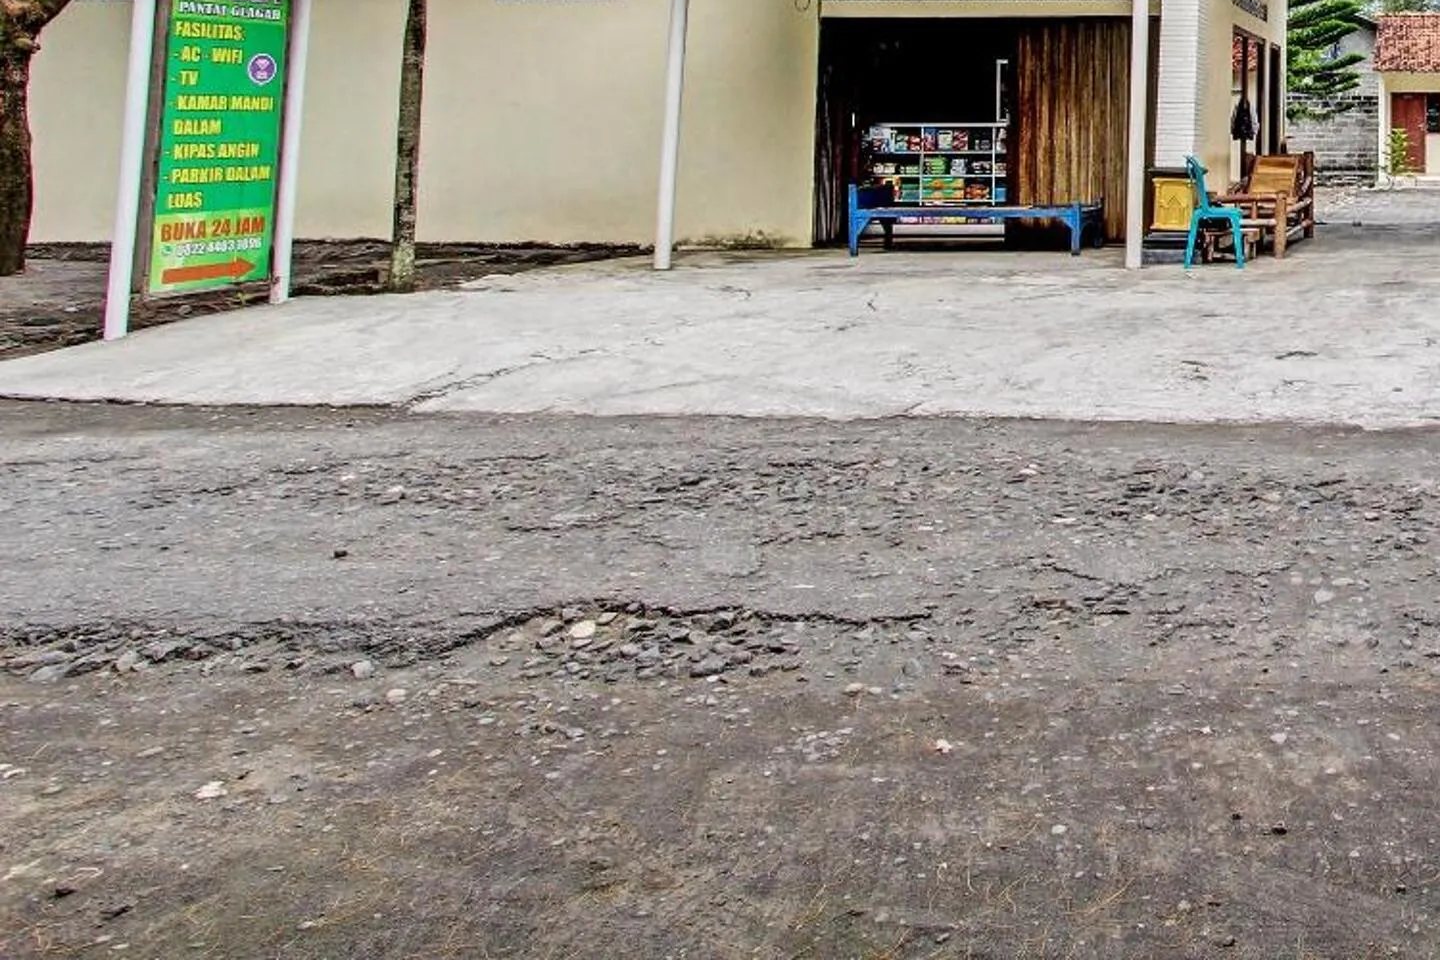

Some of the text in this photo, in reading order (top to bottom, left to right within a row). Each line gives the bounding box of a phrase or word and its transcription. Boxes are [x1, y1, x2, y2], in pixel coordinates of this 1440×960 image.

[180, 2, 226, 15] PANTAI
[180, 46, 201, 62] AC
[212, 48, 243, 64] WIFI
[180, 70, 199, 86] TV
[177, 95, 274, 110] KAMAR MANDI
[174, 119, 222, 135] DALAM
[174, 144, 215, 159] KIPAS
[217, 144, 260, 158] ANGIN
[171, 168, 223, 184] PARKIR
[225, 166, 270, 182] DALAM
[168, 192, 203, 208] LUAS
[161, 217, 265, 242] BUKA 24 JAM
